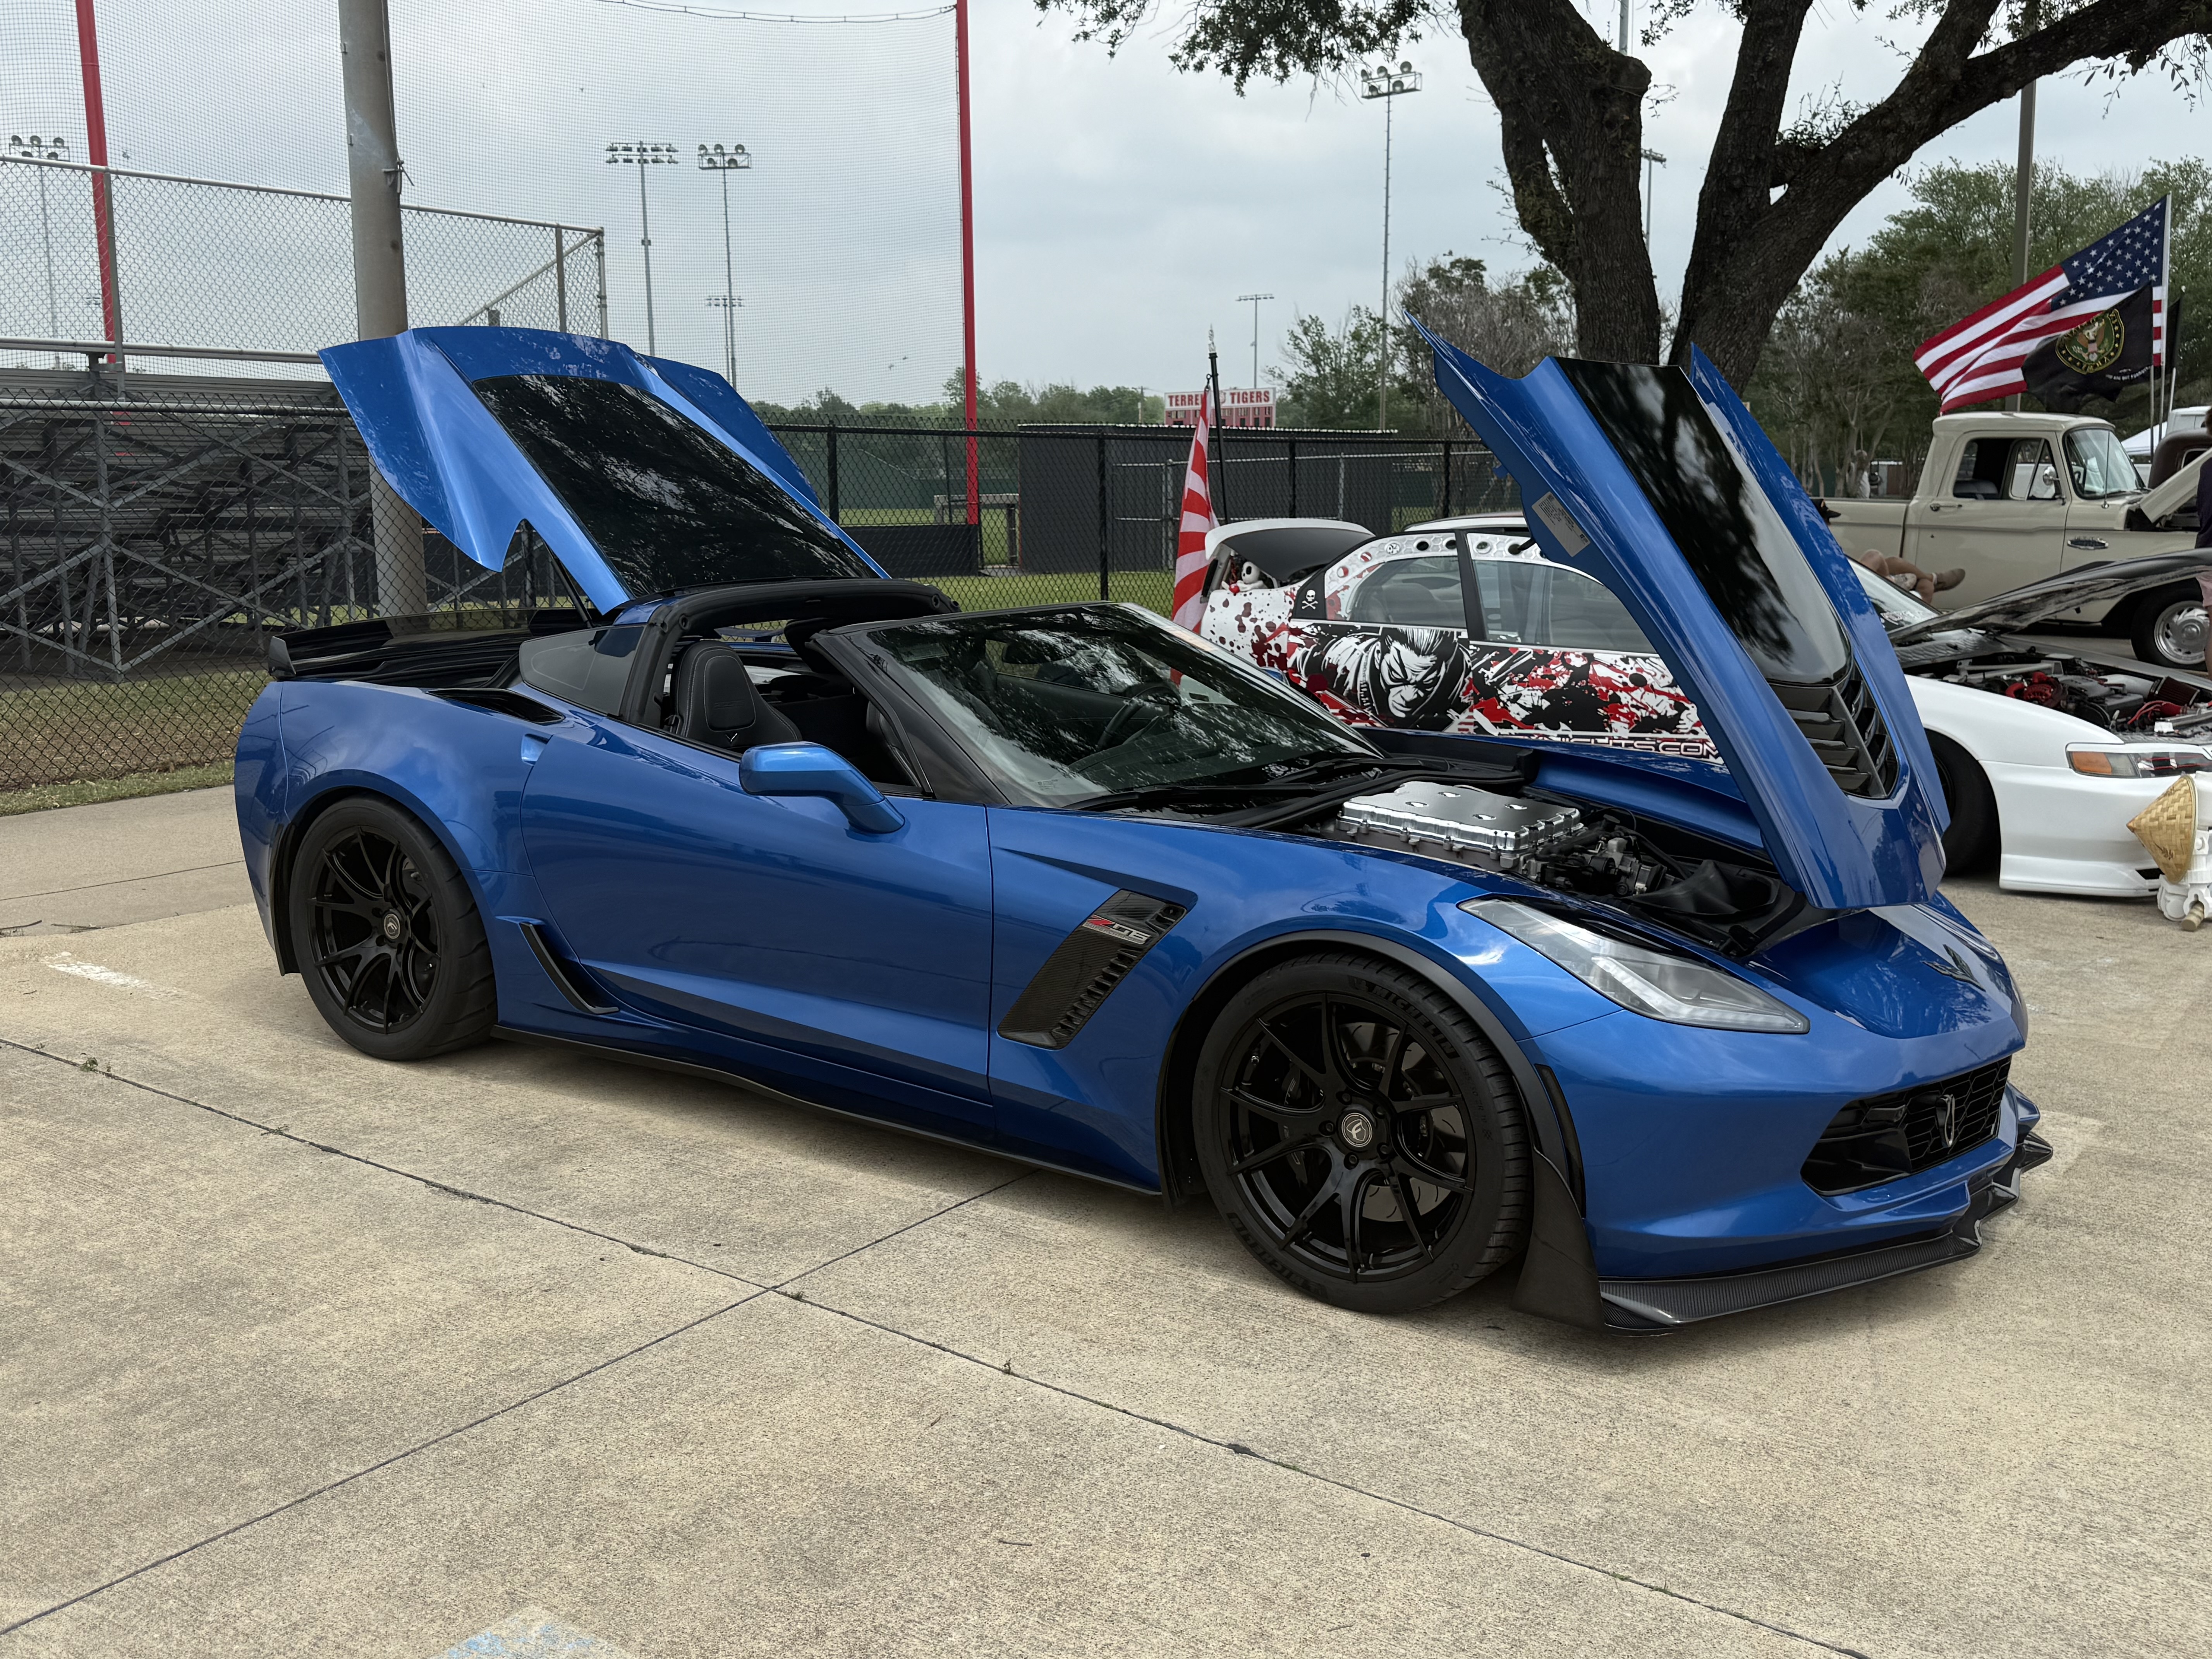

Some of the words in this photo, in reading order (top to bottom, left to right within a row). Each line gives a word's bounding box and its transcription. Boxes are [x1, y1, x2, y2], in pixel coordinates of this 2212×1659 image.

[1168, 394, 1202, 407] TERRE
[1230, 390, 1271, 404] TIGERS
[1087, 914, 1152, 942] Z06
[1372, 985, 1456, 1053] MICHELIN
[1228, 1217, 1304, 1287] MICHELIN
